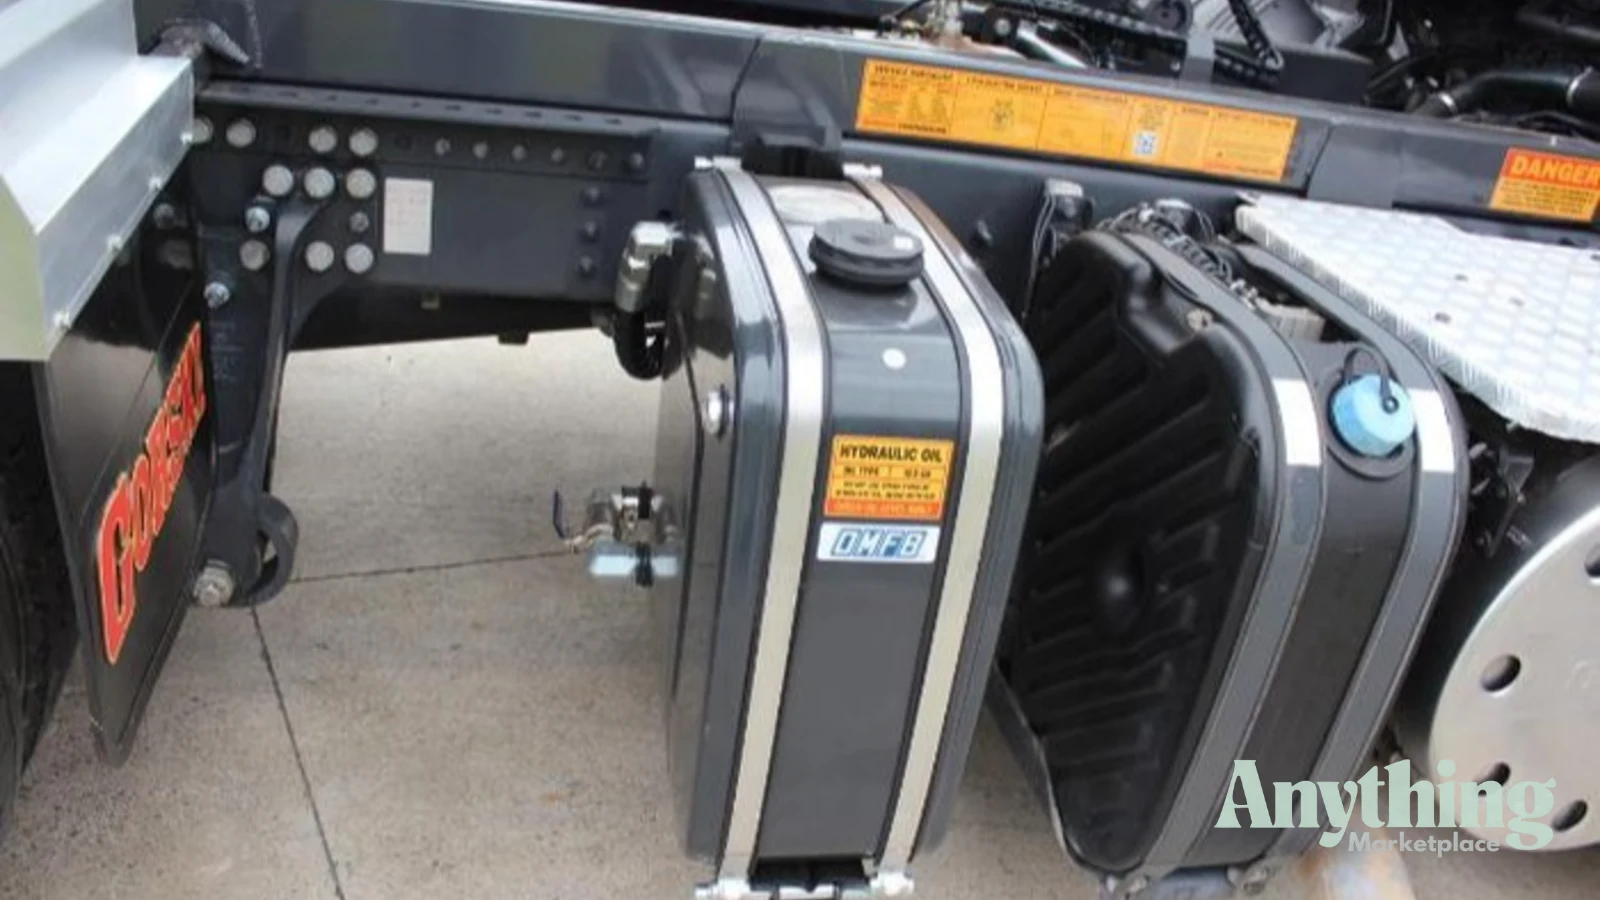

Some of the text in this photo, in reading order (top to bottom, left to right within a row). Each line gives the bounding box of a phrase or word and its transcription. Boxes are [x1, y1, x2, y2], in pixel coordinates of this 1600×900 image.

[1511, 155, 1600, 187] DANGER
[840, 444, 943, 463] HYDRAULIC OIL
[832, 530, 925, 557] OMFB
